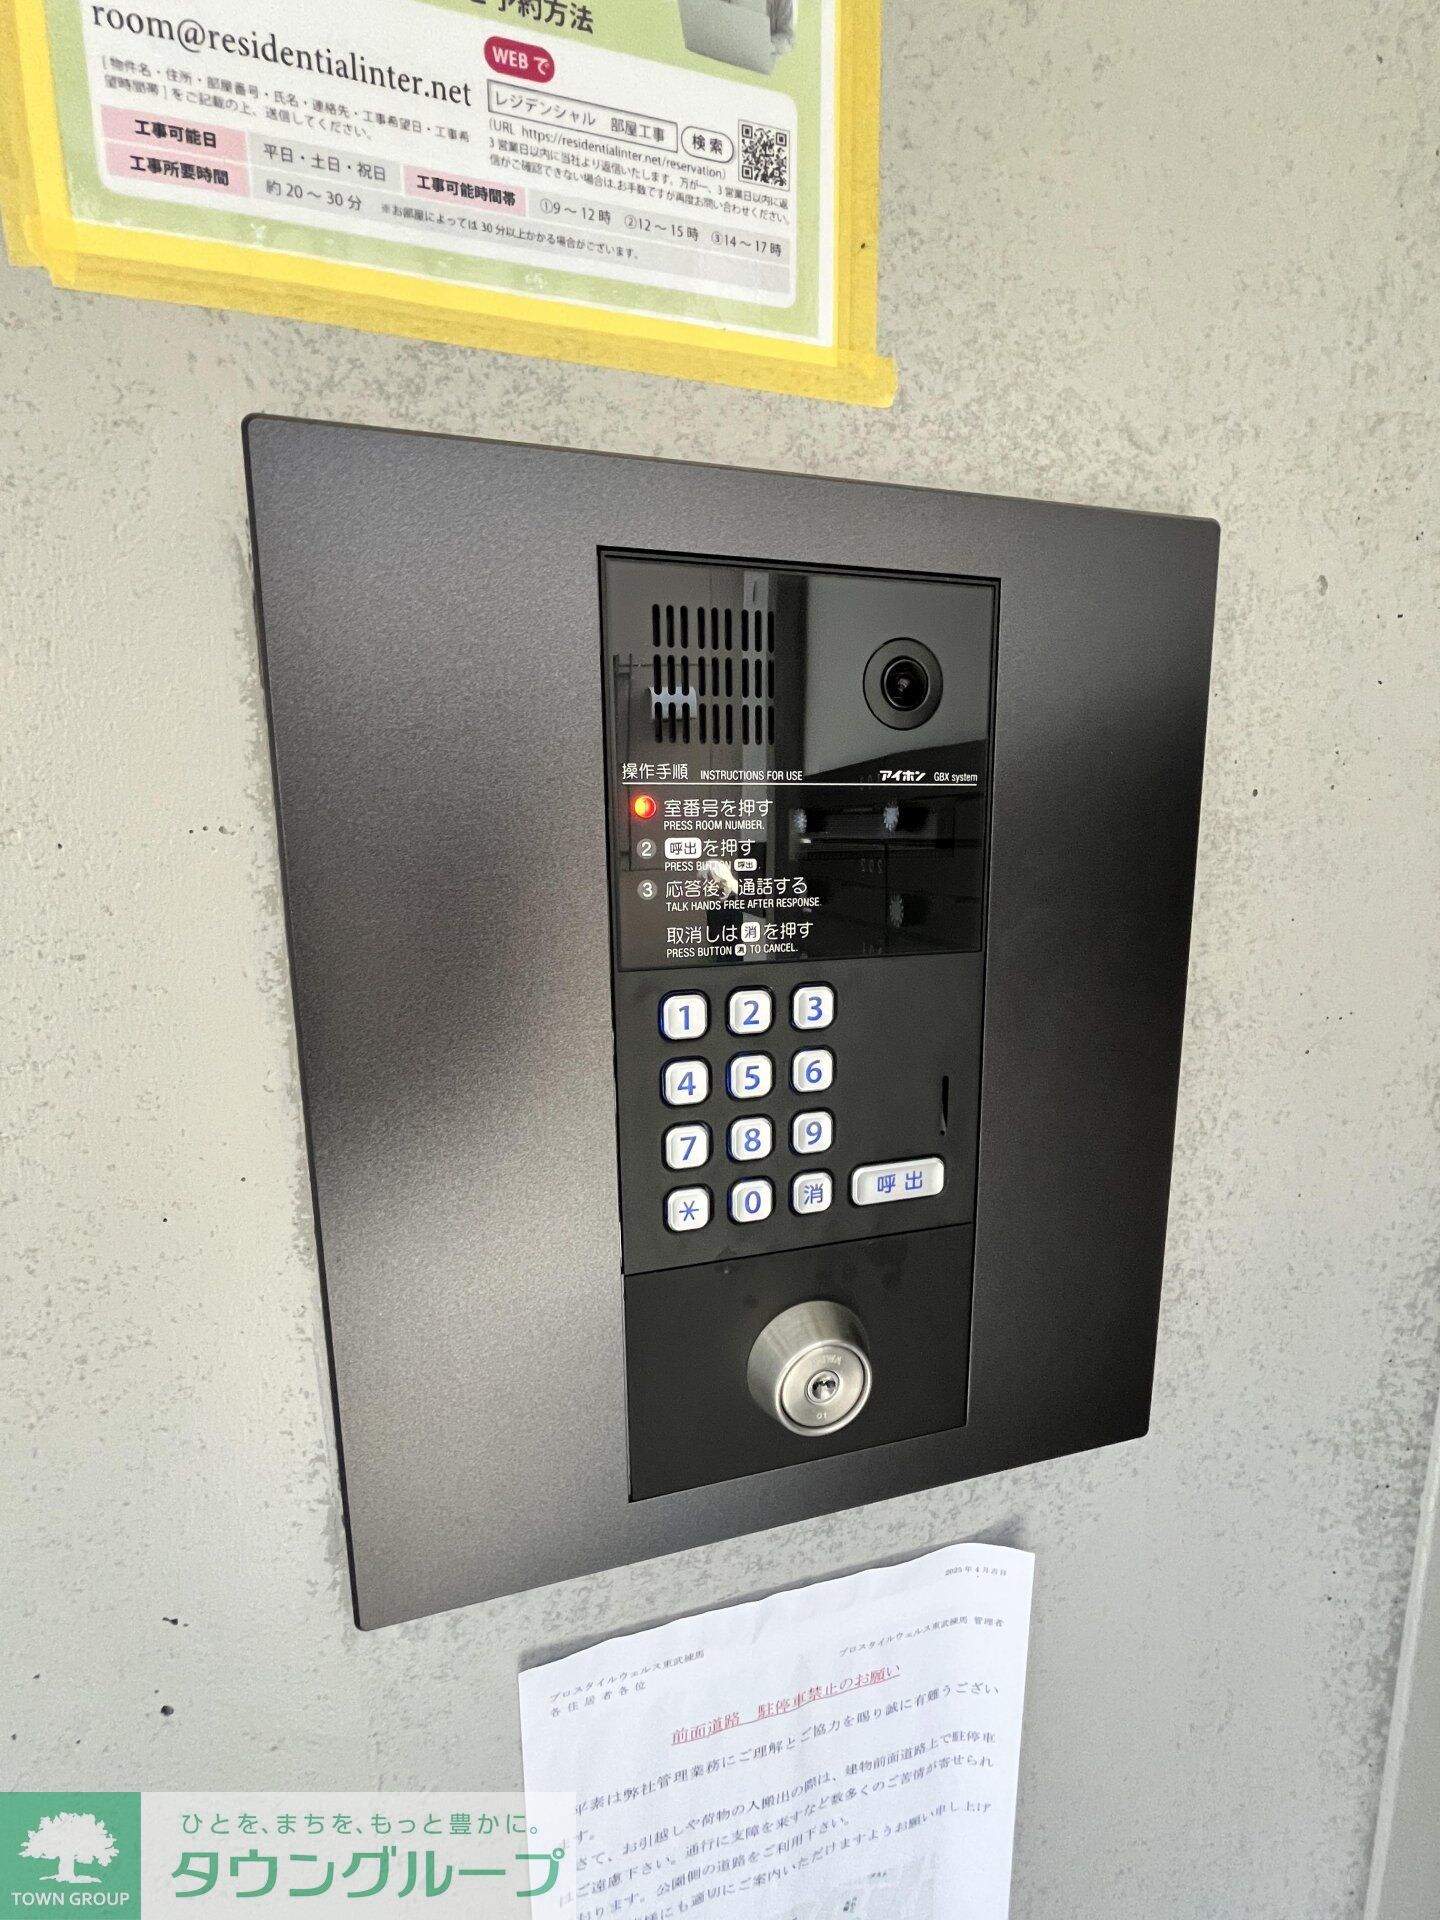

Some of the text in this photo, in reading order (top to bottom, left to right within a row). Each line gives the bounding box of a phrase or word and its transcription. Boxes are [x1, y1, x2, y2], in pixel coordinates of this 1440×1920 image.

[92, 4, 472, 107] room@residentialinter.net
[134, 119, 217, 148] 工事可能日
[495, 91, 723, 156] レジデンシャル 部屋工事 検索
[130, 155, 230, 186] 工事所要時間
[264, 143, 386, 181] 平日・土日・祝日
[416, 175, 517, 207] 工事可能時間帯
[622, 763, 689, 780] 操作手順
[700, 770, 764, 781] INSTRUCTIONS
[767, 770, 784, 781] FOR
[786, 770, 803, 781] USE
[879, 770, 927, 782] アイホン
[933, 771, 950, 782] GBX
[951, 772, 978, 783] system
[664, 799, 774, 818] 室番号を押す
[664, 820, 765, 831] PRESS ROOM NUMBER.
[664, 861, 694, 872] PRESS
[666, 897, 822, 912] TALK HANDS FREE AFTER RESPONSE.
[666, 948, 696, 958] PRESS
[698, 946, 732, 957] BUTTON
[750, 945, 762, 954] TO
[763, 943, 799, 953] CANCEL.
[678, 996, 823, 1031] 1 2 3
[677, 1059, 823, 1096] 4 5 6
[679, 1121, 823, 1161] 7 8 9
[744, 1190, 761, 1214] 0
[803, 1184, 824, 1205] 消
[876, 1170, 923, 1194] 呼出
[671, 1665, 900, 1744] 前面道路 駐停車禁止のお願い
